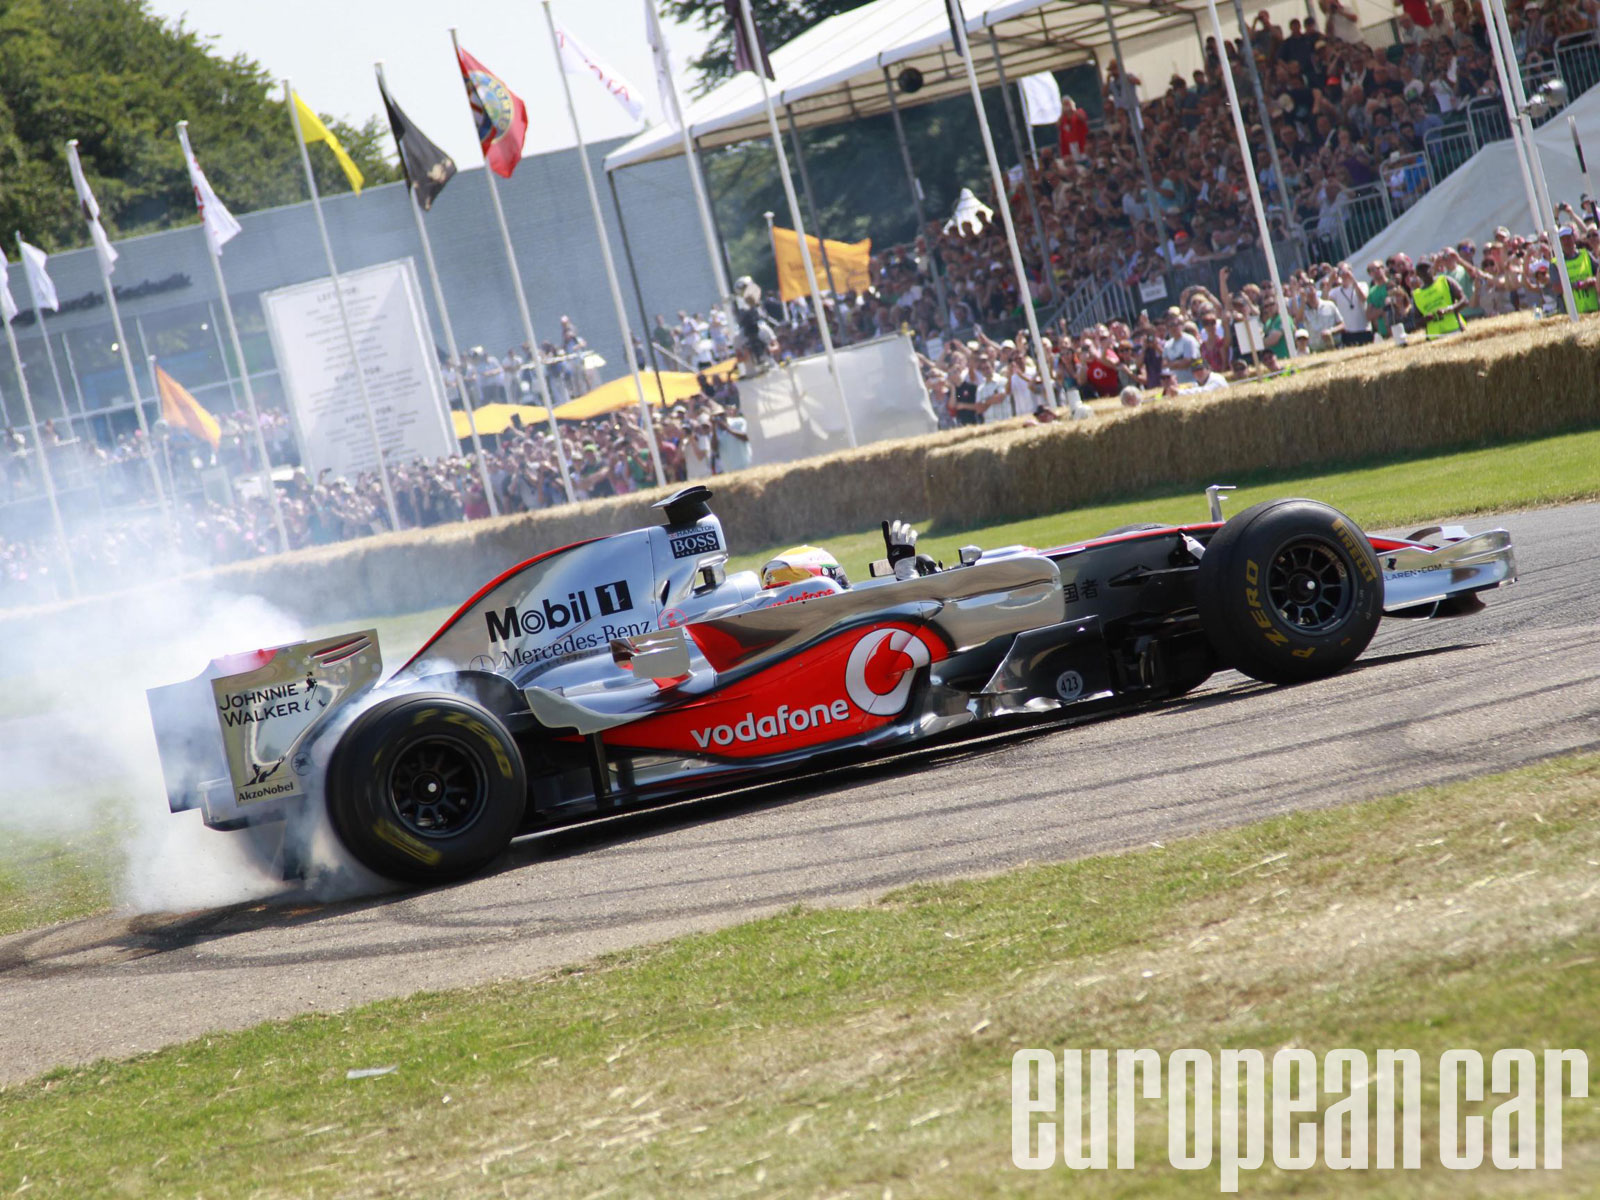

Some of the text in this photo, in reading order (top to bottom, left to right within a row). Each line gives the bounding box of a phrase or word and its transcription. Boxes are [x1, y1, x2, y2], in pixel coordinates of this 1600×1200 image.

[673, 533, 717, 553] BOSS
[1331, 518, 1378, 583] PIRELLI
[485, 582, 626, 643] Mobil 1
[1246, 558, 1289, 646] ZERO
[502, 621, 653, 670] Mercedes-Benz
[220, 683, 299, 711] JOHNNIE
[1060, 676, 1079, 694] 423
[223, 701, 301, 727] WALKER
[690, 699, 849, 748] vodafone
[238, 782, 294, 802] AkzoNobel
